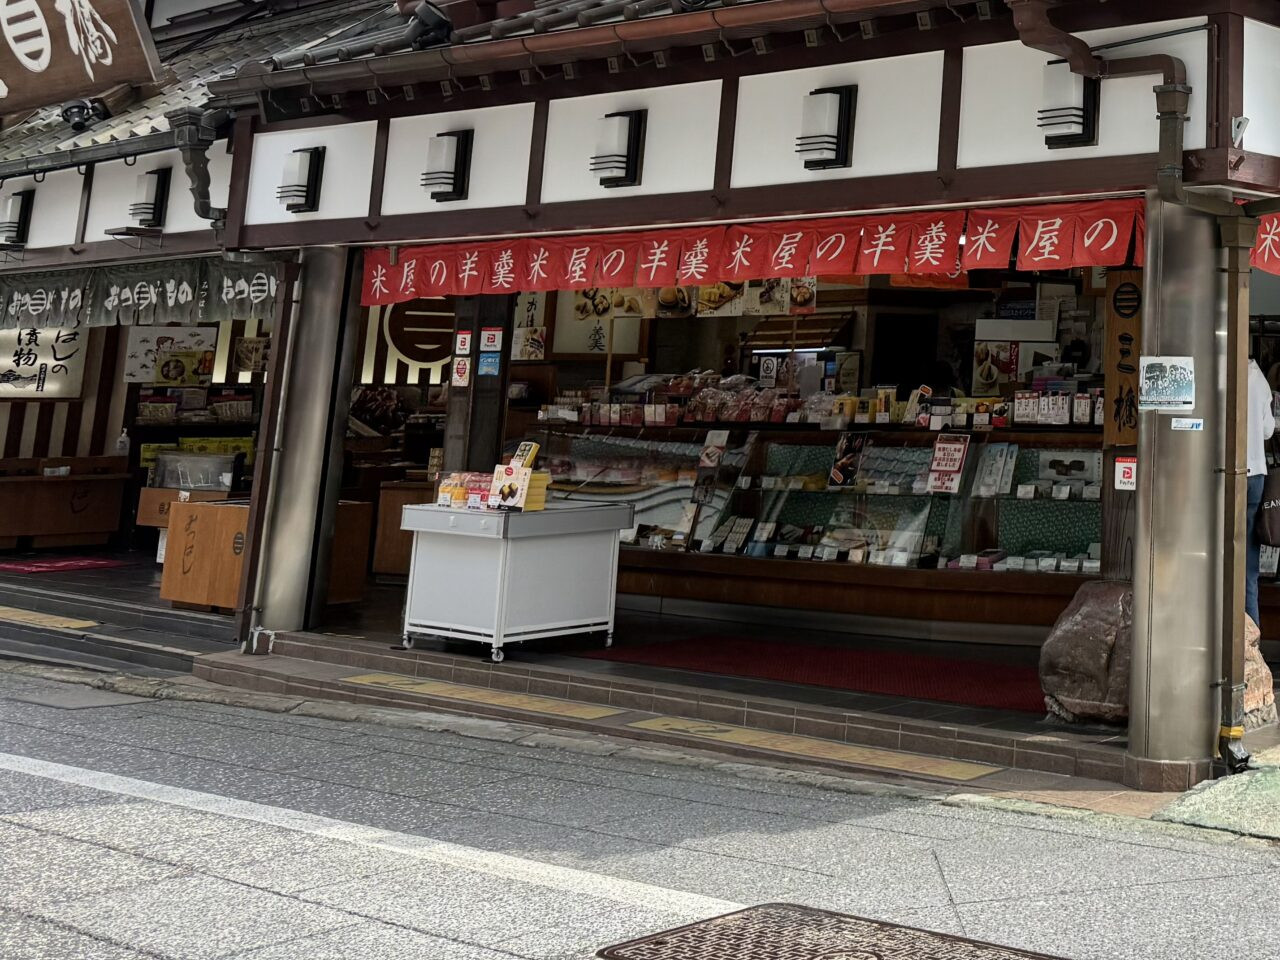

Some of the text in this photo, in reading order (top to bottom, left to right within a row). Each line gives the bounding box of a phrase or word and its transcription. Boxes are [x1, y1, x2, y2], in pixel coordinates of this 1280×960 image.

[528, 238, 710, 286] 米屋の羊羹
[727, 221, 948, 275] 米屋の羊羹
[967, 217, 1119, 262] 米屋の
[1119, 480, 1135, 488] PayPay
